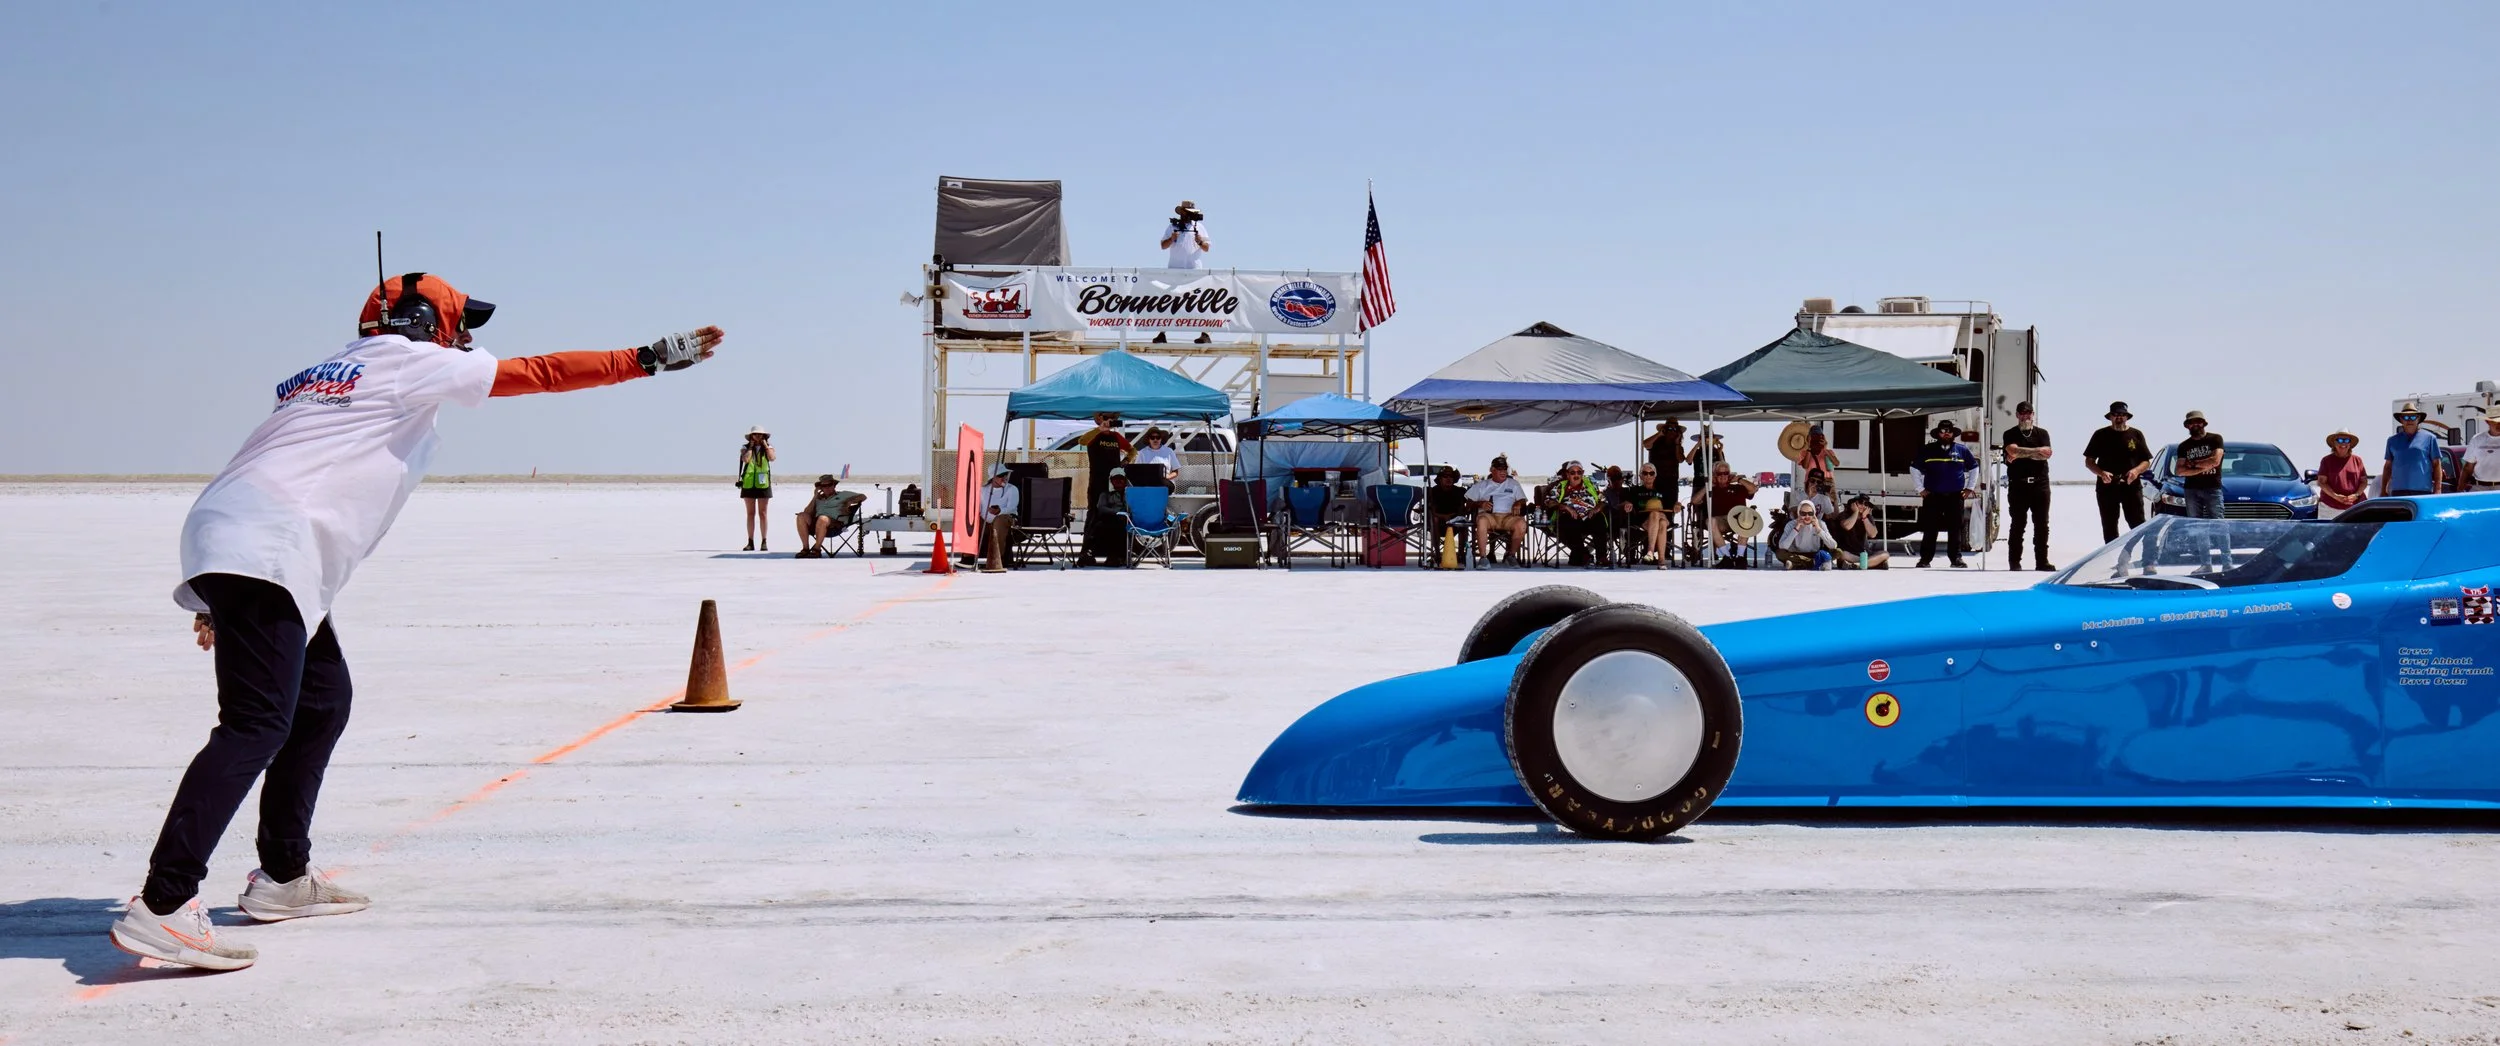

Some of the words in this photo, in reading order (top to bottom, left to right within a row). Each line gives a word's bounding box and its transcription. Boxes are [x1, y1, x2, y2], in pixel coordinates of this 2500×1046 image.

[1056, 275, 1116, 283] WELCOME
[1124, 275, 1138, 283] TO
[1271, 281, 1304, 302] BONNEVILLE
[1077, 284, 1239, 315] Bonneville
[1134, 318, 1173, 327] FASTEST
[2082, 617, 2145, 630] McMullin
[2243, 602, 2293, 614] Abbott
[2399, 647, 2433, 655] Crew:
[2399, 657, 2429, 666] Greg
[2431, 657, 2473, 665] Abbott
[2399, 667, 2449, 676] Sterling
[2452, 667, 2494, 675] Brandt
[2400, 677, 2431, 685] Dave
[2433, 677, 2467, 685] Owen
